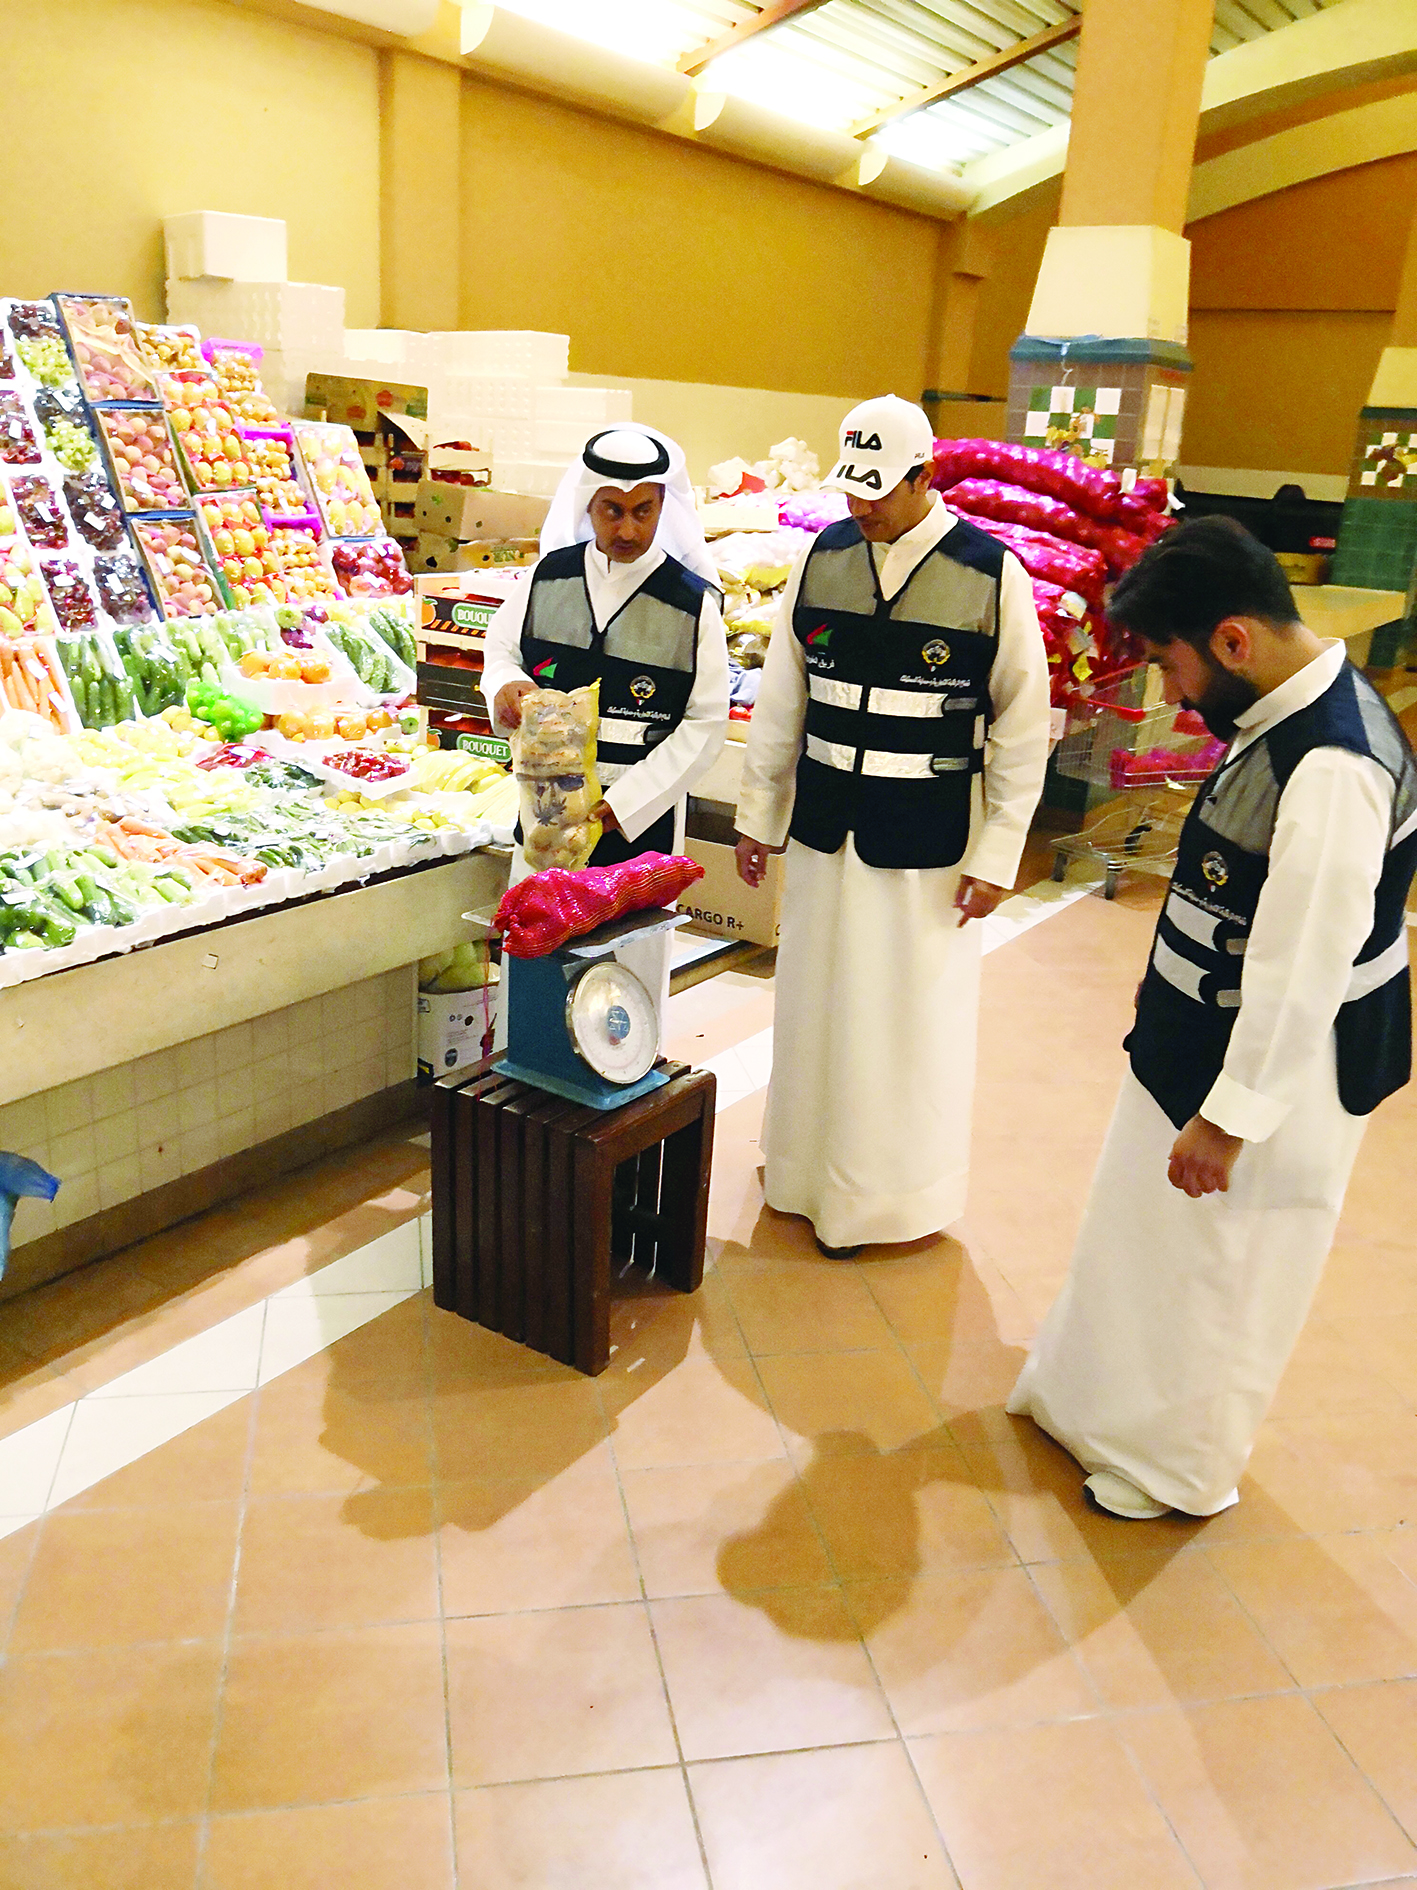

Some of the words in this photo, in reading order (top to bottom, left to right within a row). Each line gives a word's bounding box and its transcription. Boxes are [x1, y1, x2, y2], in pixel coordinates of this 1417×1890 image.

[844, 430, 882, 451] FILA
[836, 464, 882, 490] ILA
[457, 609, 490, 625] BOUQU
[462, 739, 509, 757] BOUQUET
[675, 903, 723, 925] CARGO
[726, 916, 745, 930] R+
